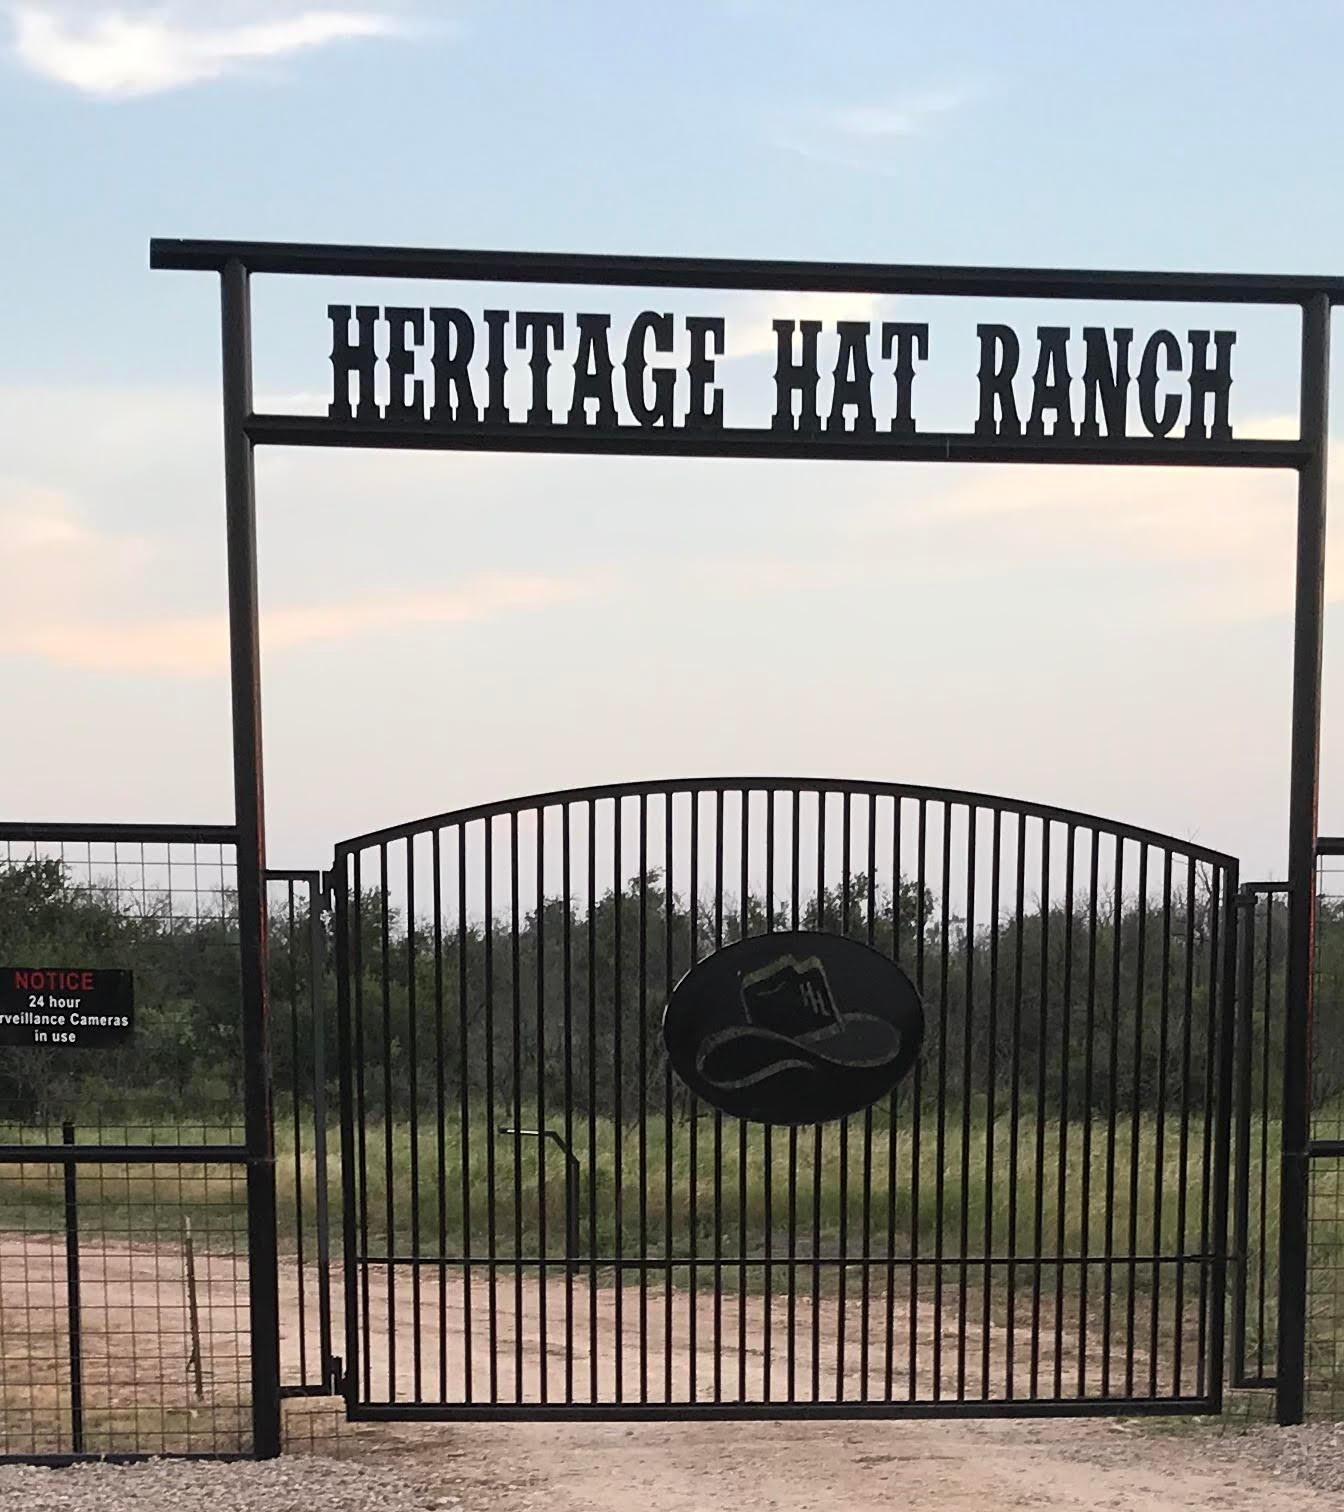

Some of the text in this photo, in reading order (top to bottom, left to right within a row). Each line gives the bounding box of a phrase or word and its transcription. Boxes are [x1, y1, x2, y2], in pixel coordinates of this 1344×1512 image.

[327, 304, 1237, 440] HERITAGE HAT RANCH
[14, 971, 95, 990] NOTICE
[28, 995, 81, 1009] 24 hour
[69, 1012, 129, 1027] Cameras
[34, 1029, 77, 1043] in use
